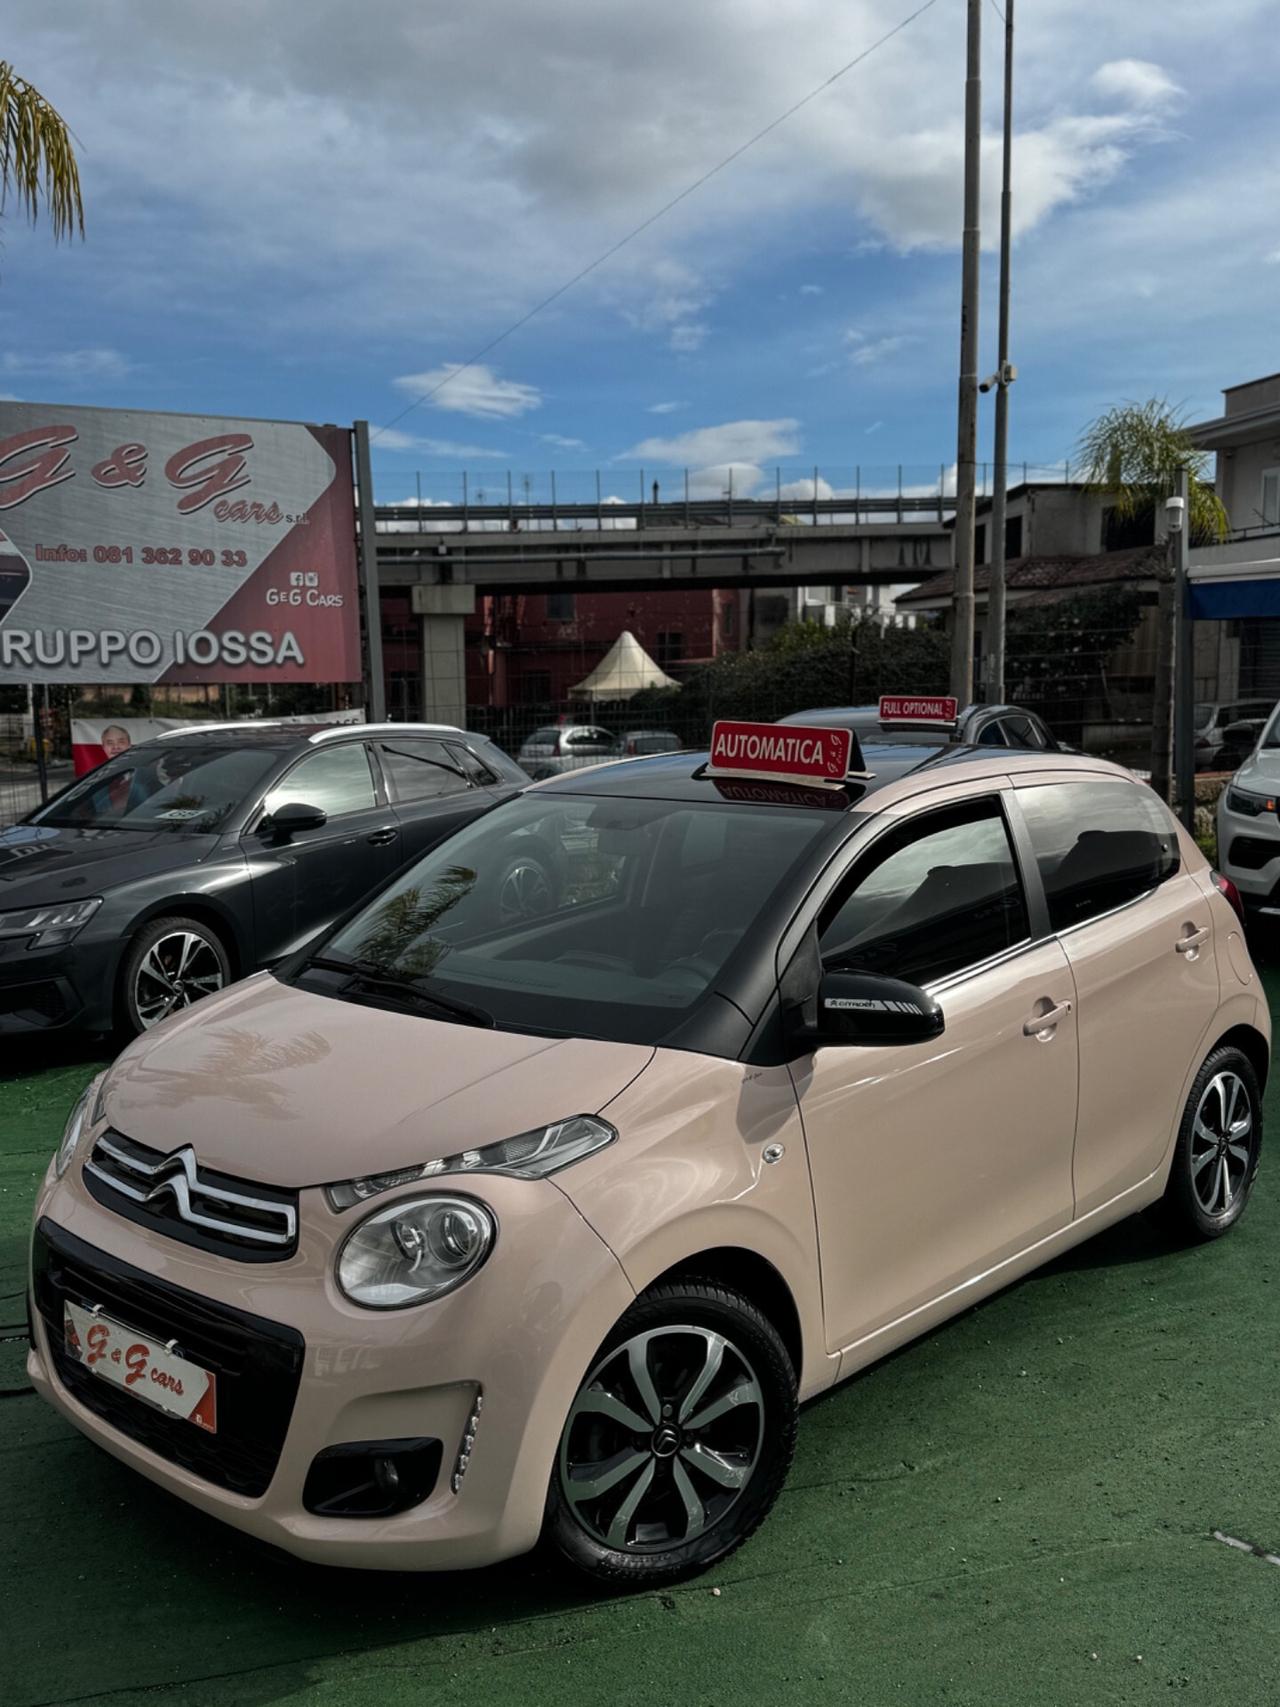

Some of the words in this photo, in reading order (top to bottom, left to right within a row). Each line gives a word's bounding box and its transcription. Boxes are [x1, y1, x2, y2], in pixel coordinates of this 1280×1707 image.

[91, 442, 148, 489] &
[164, 432, 253, 515] G
[213, 499, 284, 525] cars
[35, 543, 87, 562] Info:
[93, 545, 133, 564] 081
[141, 547, 182, 566] 362
[187, 548, 215, 566] 90
[220, 549, 248, 568] 33
[173, 629, 305, 666] IOSSA
[882, 701, 902, 714] FULL
[902, 702, 943, 716] OPTIONAL
[714, 733, 824, 765] AUTOMATICA
[86, 1323, 111, 1366] G
[125, 1344, 150, 1386] G
[150, 1367, 184, 1396] cars
